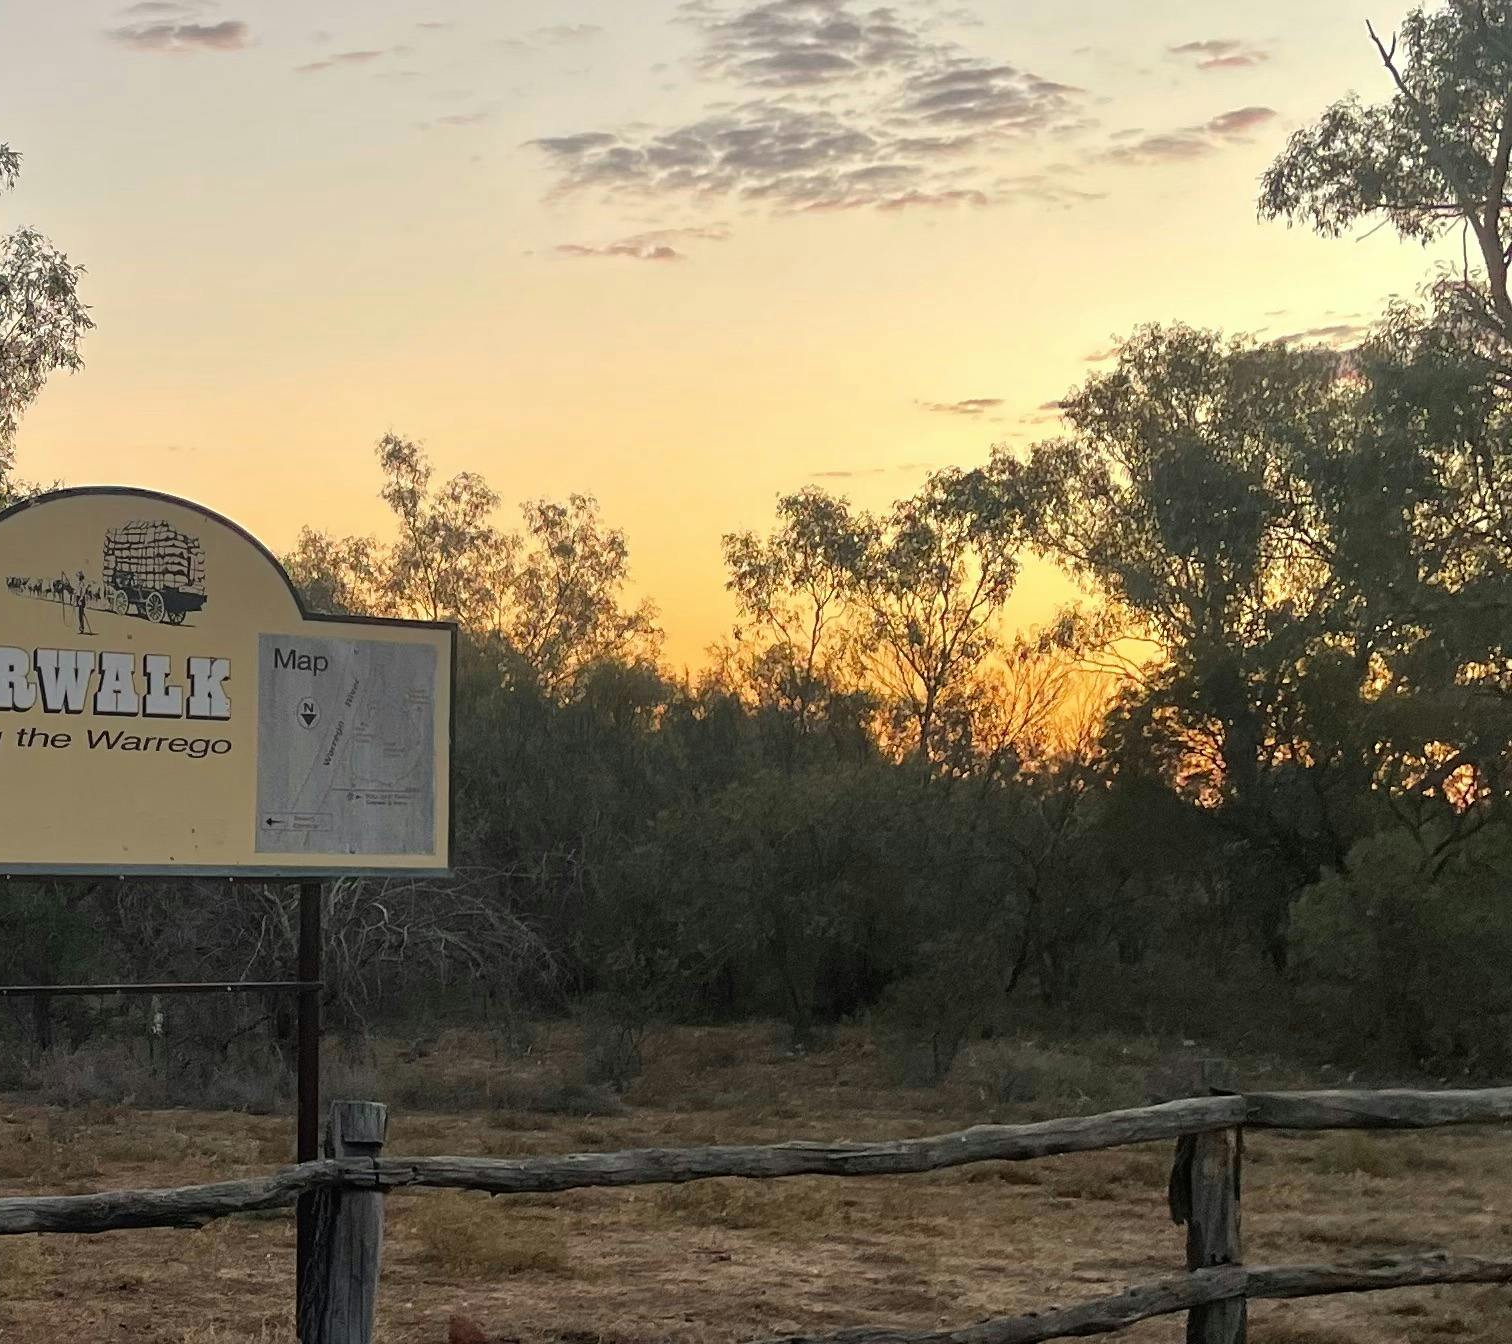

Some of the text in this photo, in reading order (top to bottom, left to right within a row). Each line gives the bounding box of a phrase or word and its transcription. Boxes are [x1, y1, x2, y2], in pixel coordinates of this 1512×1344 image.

[273, 647, 329, 676] Map
[303, 702, 314, 713] N
[16, 726, 72, 748] the
[86, 729, 233, 758] Warrego
